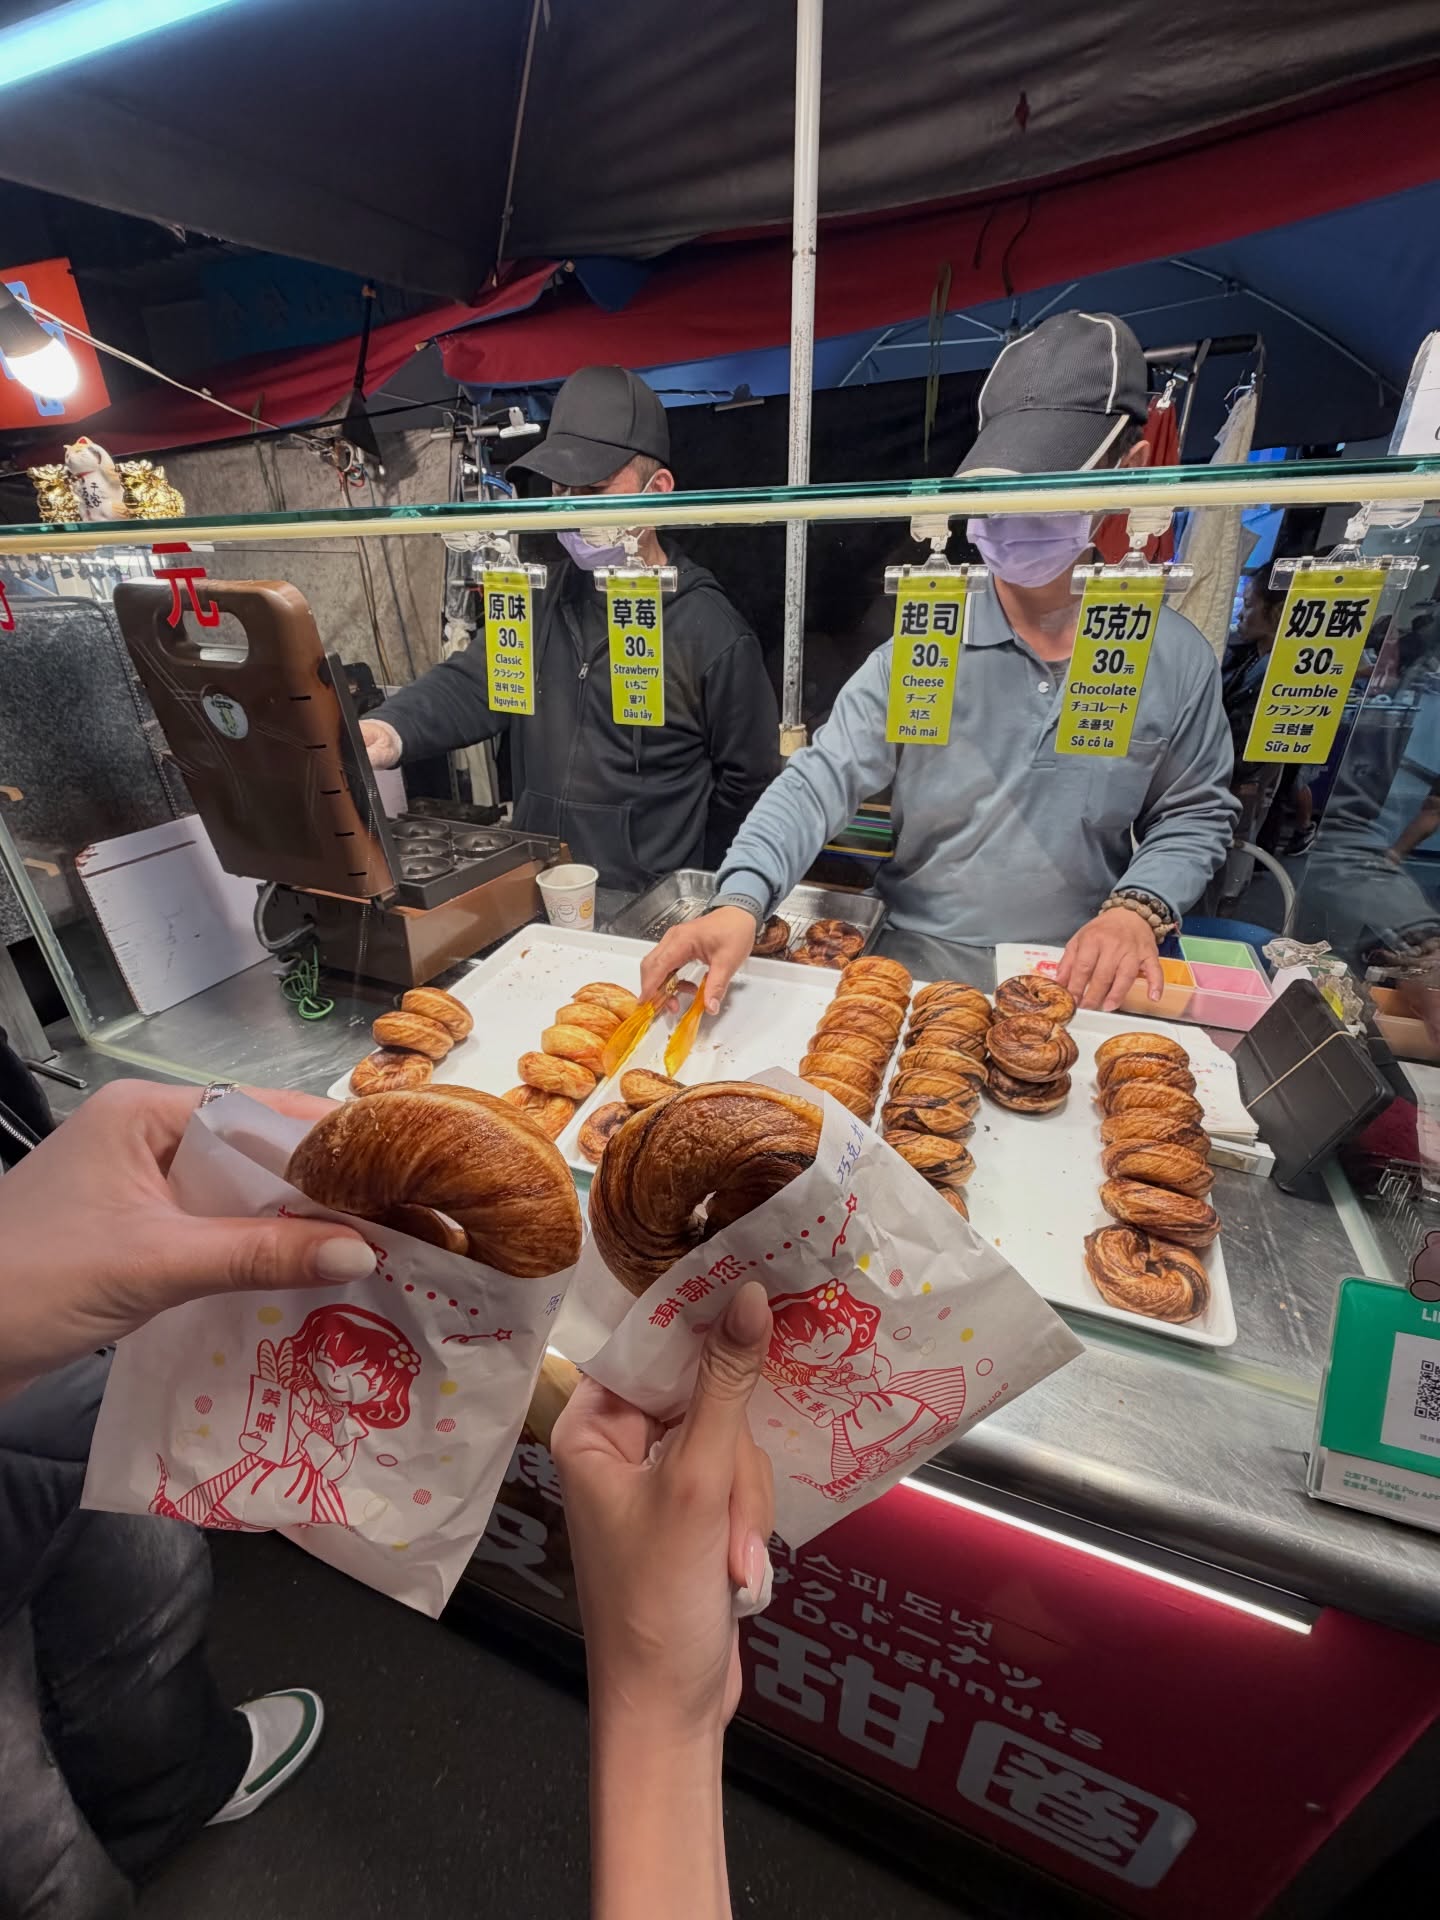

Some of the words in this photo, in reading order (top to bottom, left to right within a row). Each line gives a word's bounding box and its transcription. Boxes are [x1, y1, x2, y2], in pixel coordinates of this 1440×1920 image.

[489, 593, 526, 622] 原味
[612, 598, 656, 629] 草莓
[901, 602, 959, 636] 起司
[1082, 602, 1152, 641] 巧克力
[1285, 599, 1370, 638] 奶酥
[499, 628, 524, 649] 30元
[625, 636, 654, 658] 30元
[495, 653, 522, 665] Classic
[912, 643, 949, 668] 30元
[1092, 648, 1135, 675] 30元
[1294, 648, 1344, 675] 30元
[493, 668, 525, 679] クラシック
[614, 663, 659, 678] Strawberry
[625, 680, 648, 689] いちご
[902, 675, 944, 688] Cheese
[1070, 682, 1137, 697] Chocolate
[1272, 683, 1338, 698] Crumble
[629, 694, 646, 704] 딸기
[906, 693, 936, 704] チーズ
[909, 709, 930, 720] 치즈
[1071, 701, 1128, 714] チョコレート
[1265, 704, 1331, 717] クランブル
[899, 725, 917, 737] Phô
[920, 726, 938, 737] mai
[1077, 718, 1114, 731] 초콜릿
[1272, 723, 1314, 736] 크럼블
[1087, 736, 1101, 748] cô
[1103, 737, 1114, 748] la
[1265, 740, 1289, 753] Sữa
[648, 1255, 747, 1328] 謝謝您
[256, 1388, 282, 1433] 美味
[899, 1590, 994, 1646] 도넛
[861, 1602, 1043, 1689] ドーナツ
[793, 1598, 1103, 1750] Doughnuts
